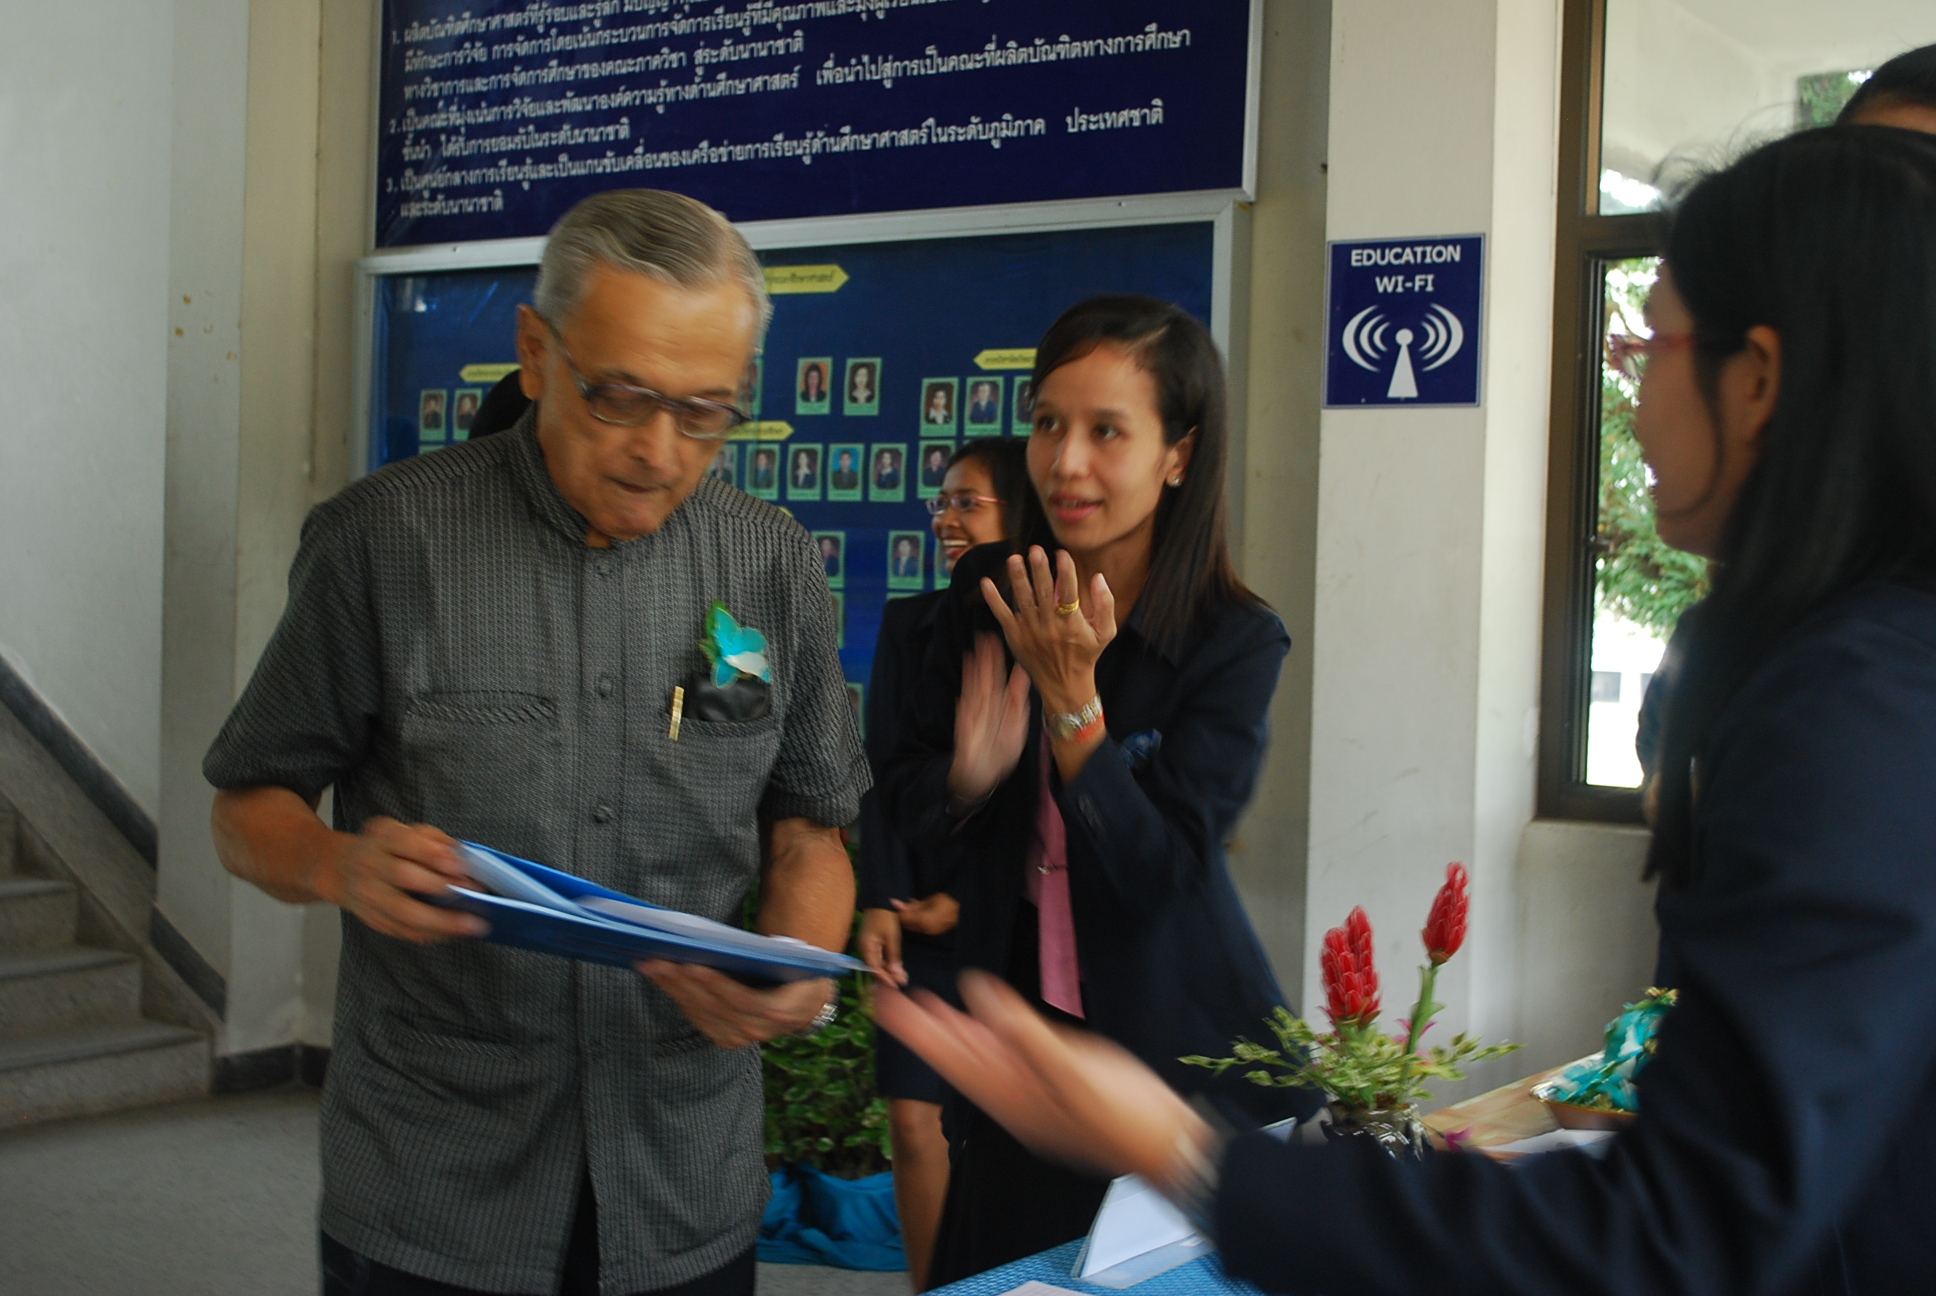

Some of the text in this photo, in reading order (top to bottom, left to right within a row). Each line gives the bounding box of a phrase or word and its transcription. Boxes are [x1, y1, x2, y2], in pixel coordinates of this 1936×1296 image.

[816, 22, 1192, 89] เพื่อนำไปสู่การเป็นคณะที่ผลิตบัณฑิตทางการศึกษา
[1065, 98, 1163, 133] ประเทศชาติ
[1350, 244, 1462, 267] EDUCATION
[1375, 274, 1435, 293] WI-FI
